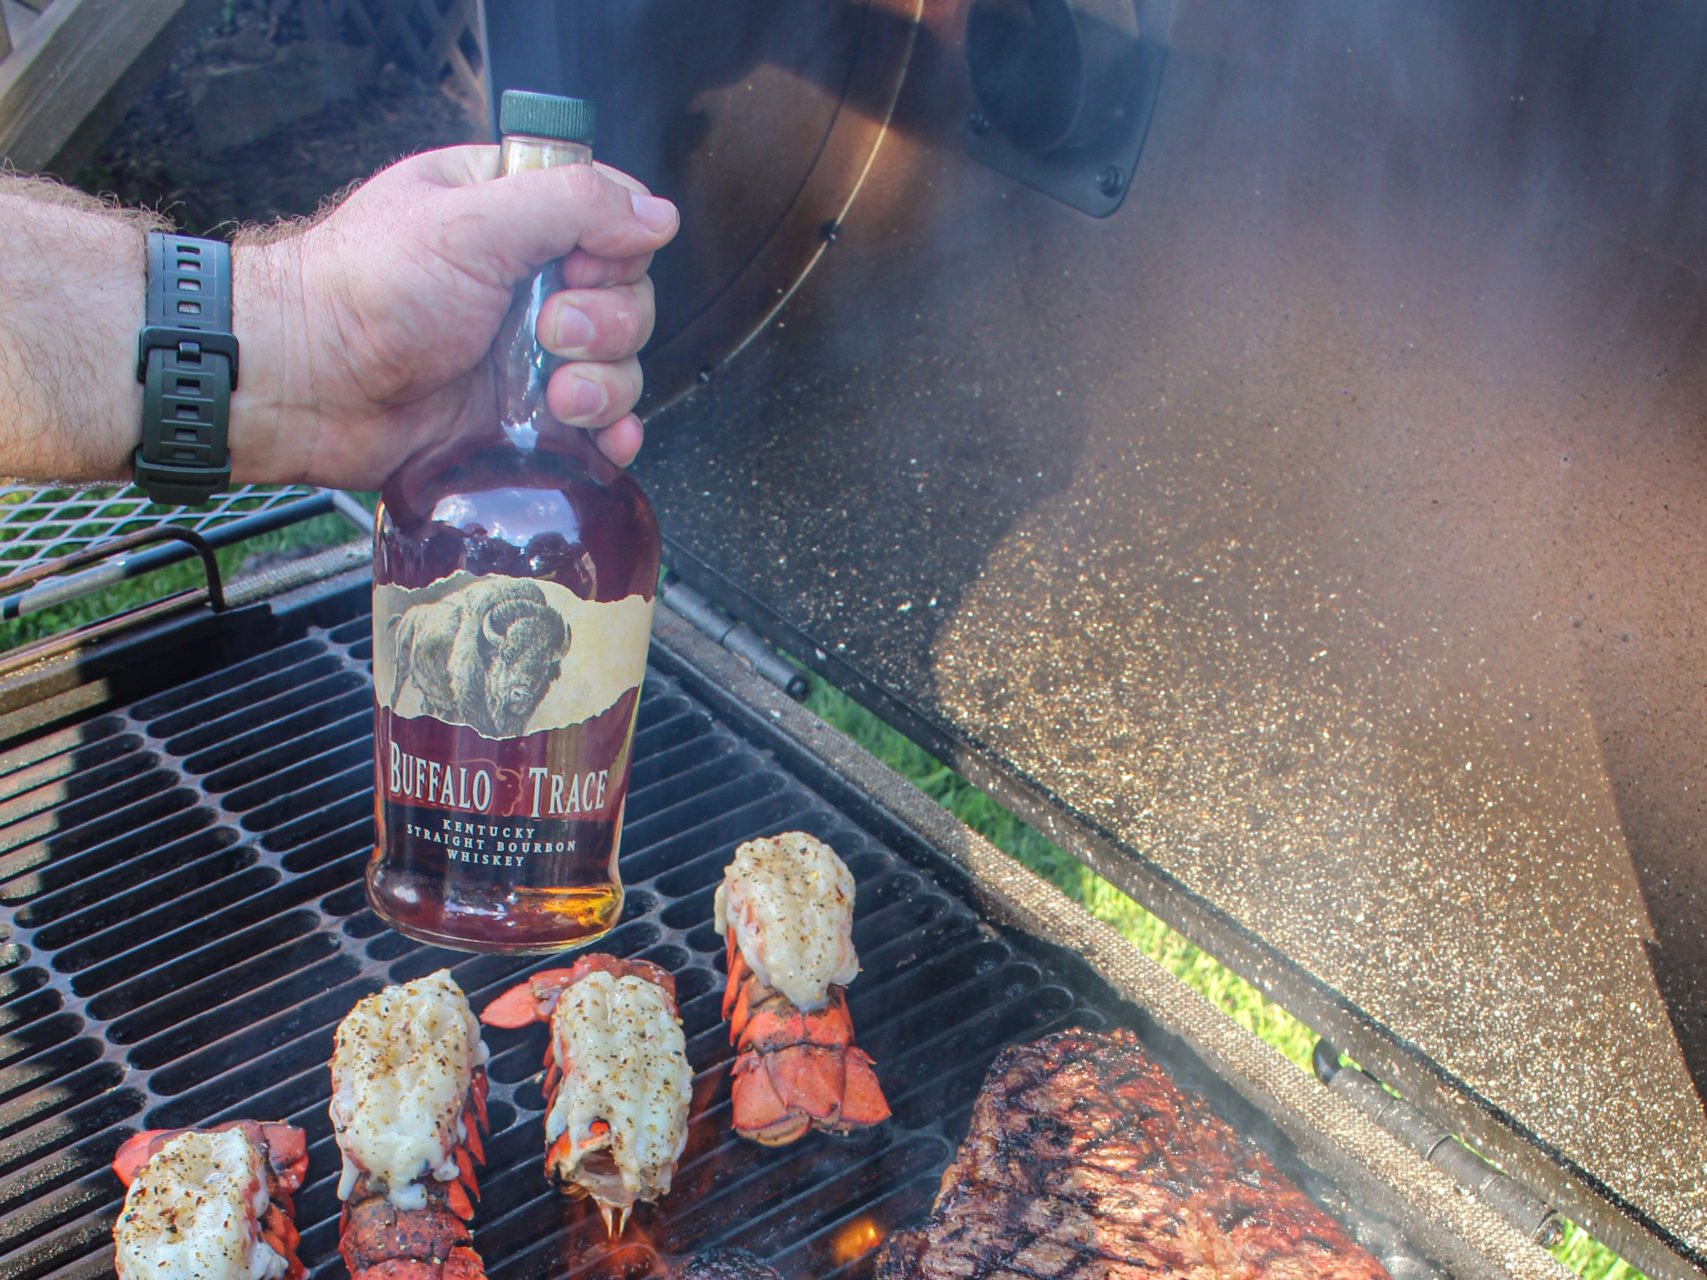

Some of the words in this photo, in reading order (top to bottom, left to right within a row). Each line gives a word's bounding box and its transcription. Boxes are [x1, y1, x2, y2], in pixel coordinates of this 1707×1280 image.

[389, 741, 491, 812] BUFFALO
[529, 767, 608, 818] TRACE
[407, 824, 485, 850] STRAIGHT
[496, 840, 576, 853] BOURBON
[443, 819, 536, 839] KENTUCKY
[446, 849, 525, 867] WHISKEY
